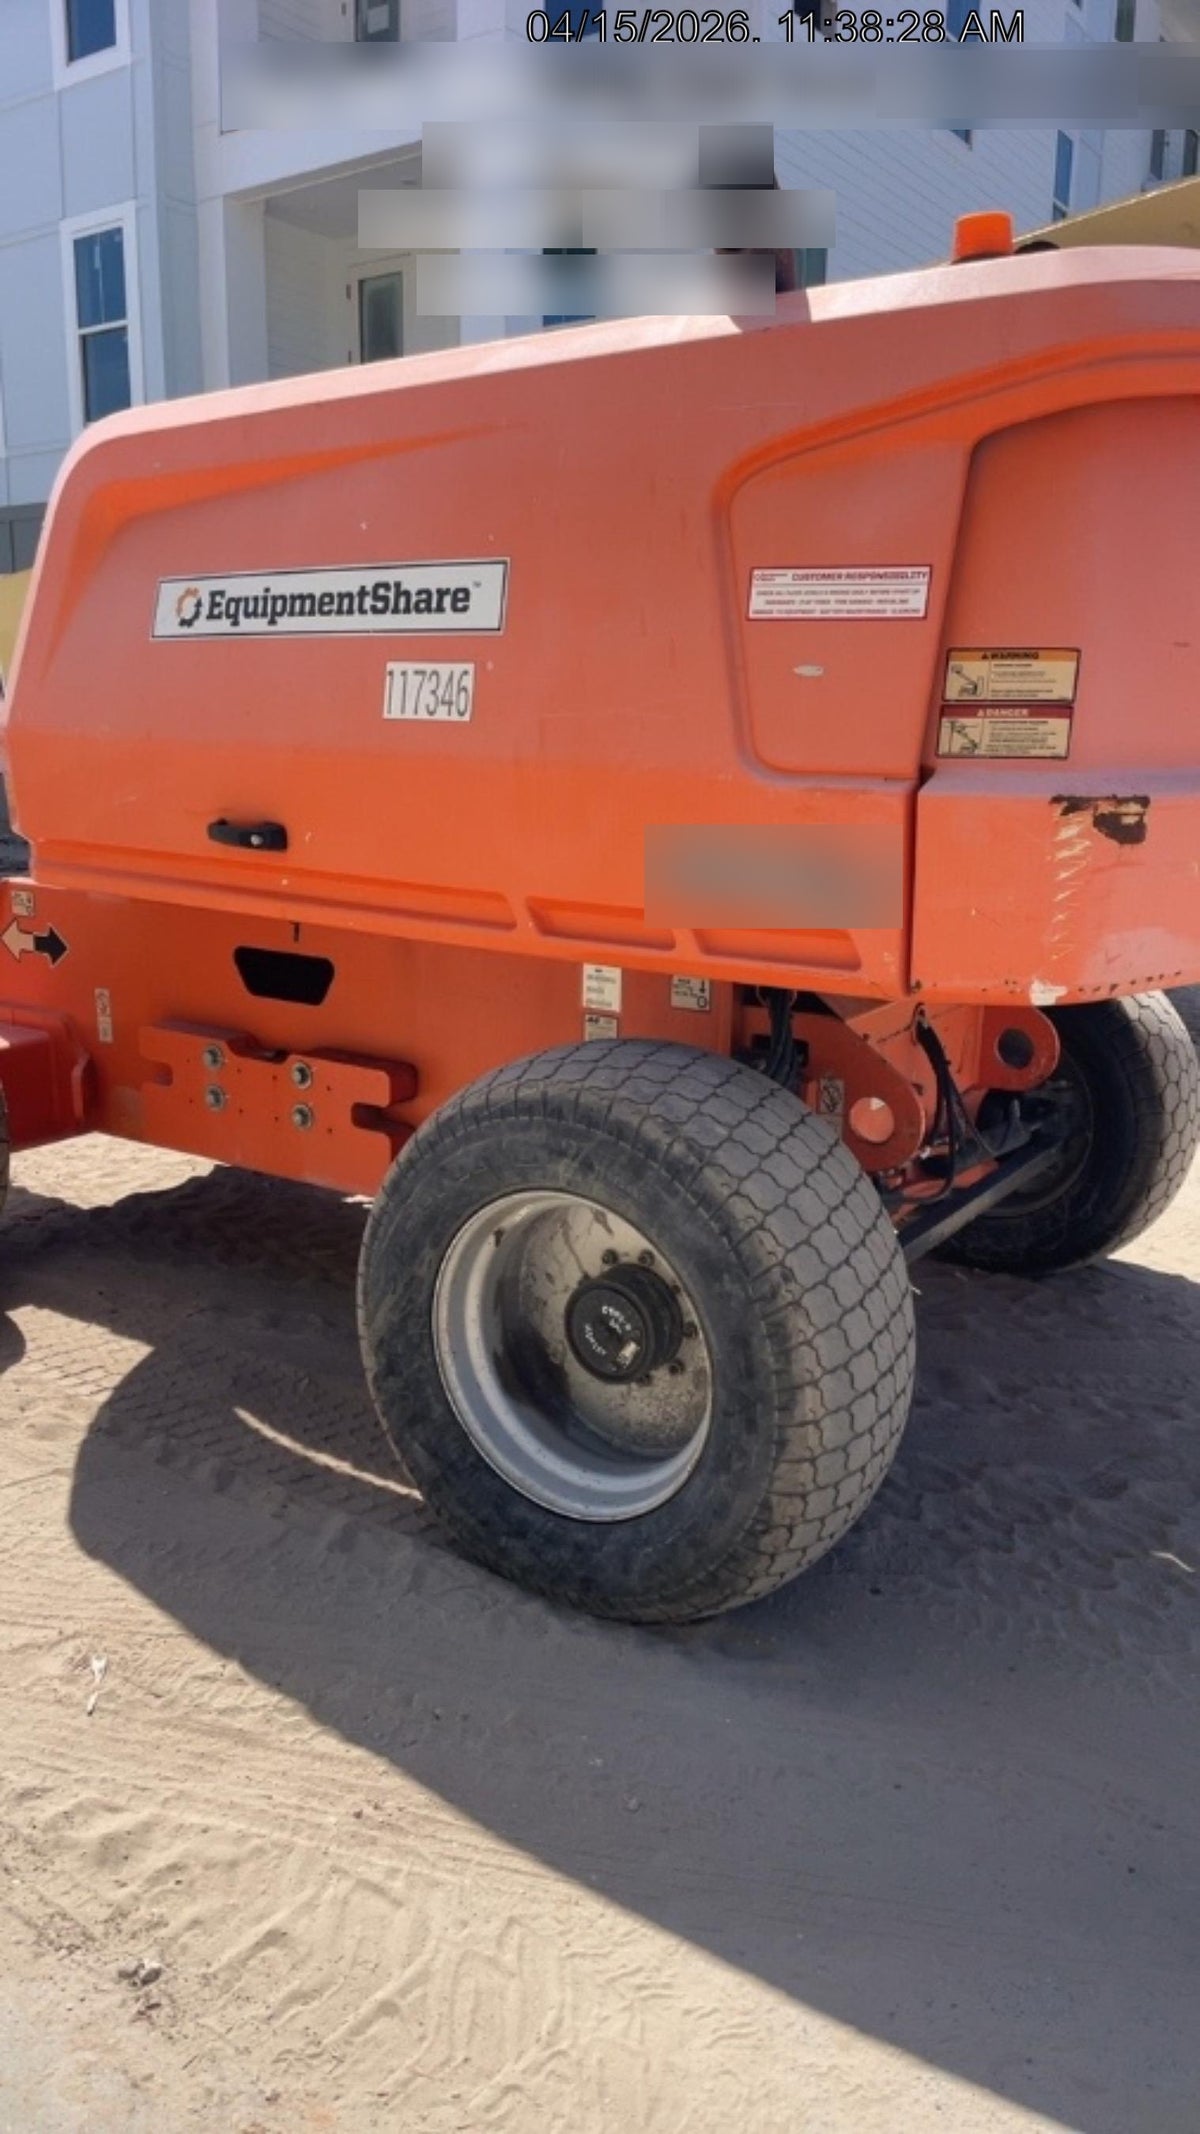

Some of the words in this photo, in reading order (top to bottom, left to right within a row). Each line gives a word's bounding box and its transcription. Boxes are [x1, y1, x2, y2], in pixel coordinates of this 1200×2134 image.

[791, 573, 843, 581] CUSTOMER
[845, 571, 928, 581] RESPONSIBILITY
[206, 582, 471, 627] EquipmentShare
[990, 652, 1040, 660] WARNING
[387, 669, 471, 717] 117346
[985, 708, 1029, 717] DANGER
